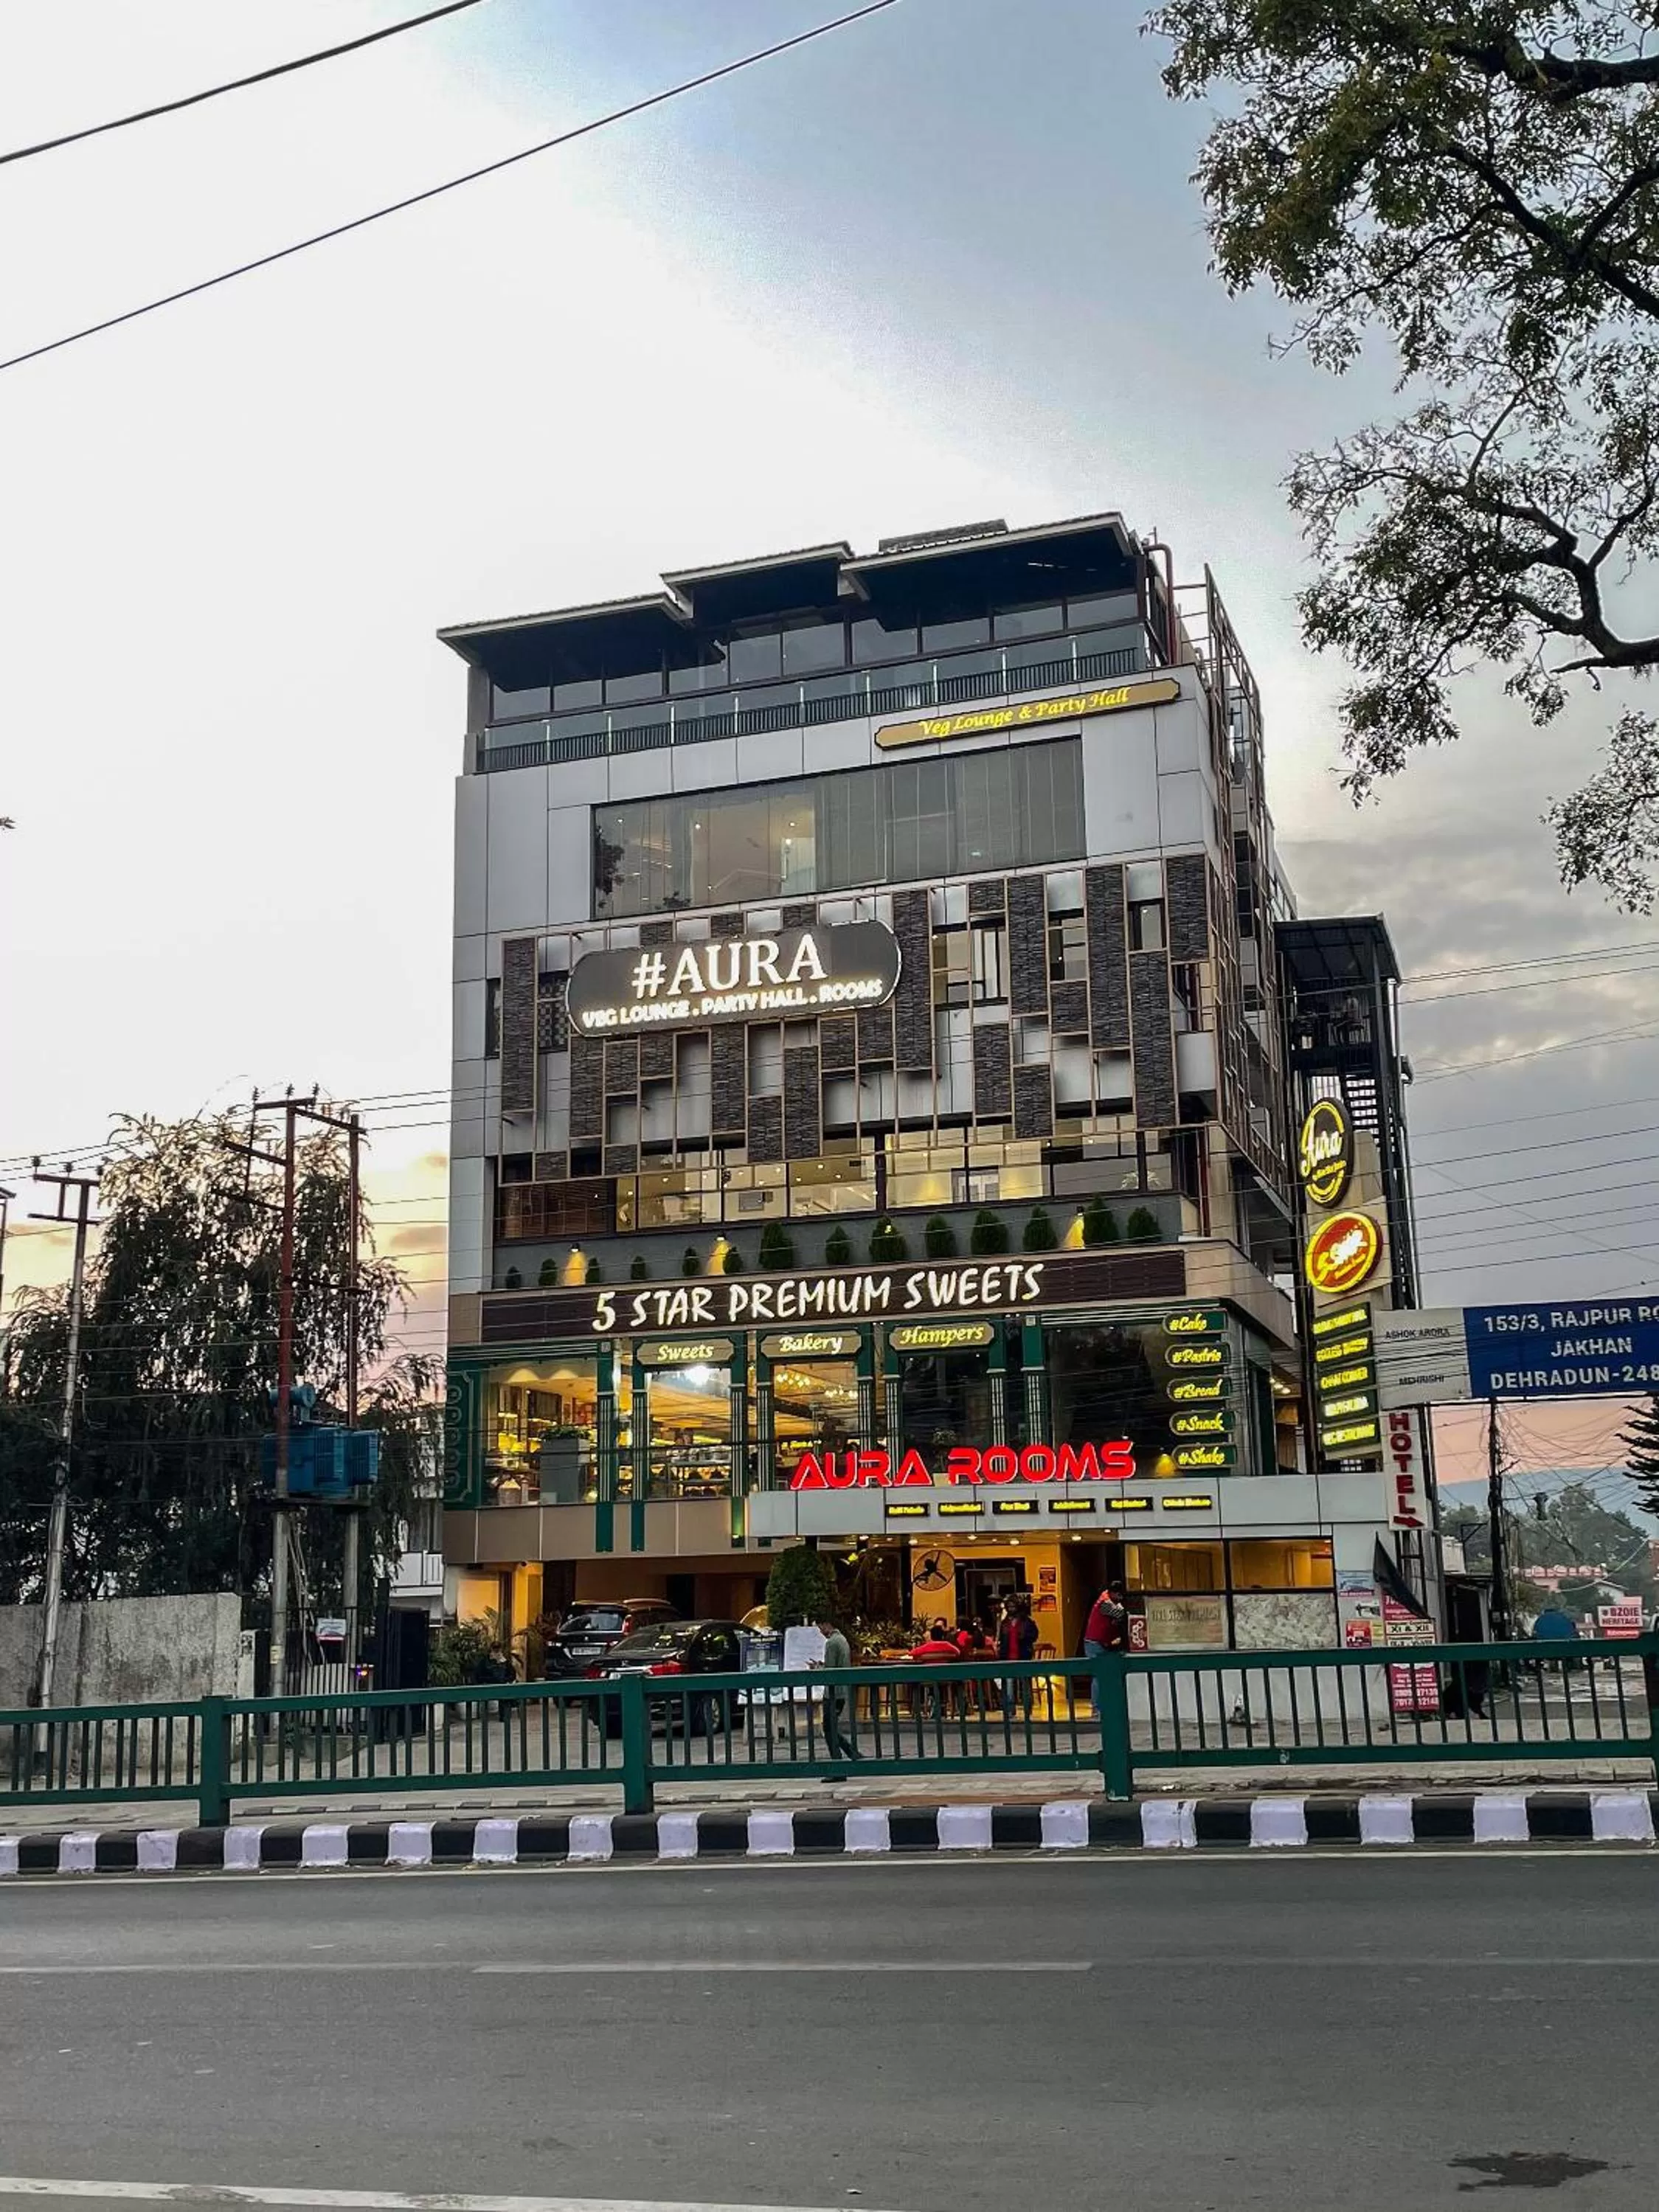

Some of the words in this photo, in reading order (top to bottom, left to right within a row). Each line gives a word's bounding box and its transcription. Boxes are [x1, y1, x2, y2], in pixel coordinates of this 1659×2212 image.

[920, 721, 950, 737] Veg
[954, 710, 1014, 731] Lounge
[1019, 707, 1033, 721] &
[1036, 698, 1087, 717] Party
[1088, 687, 1132, 707] Hall
[631, 933, 828, 999] #AURA
[583, 1008, 617, 1029] VEG
[620, 999, 690, 1024] LOUNGE
[702, 992, 758, 1015] PARTY
[761, 987, 808, 1010] HALL
[819, 979, 883, 1003] ROOMS
[592, 1292, 616, 1331] 5
[630, 1286, 716, 1327] STAR
[728, 1275, 890, 1322] PREMIUM
[903, 1263, 1045, 1310] SWEETS
[1169, 1313, 1208, 1331] #Cake
[1484, 1313, 1545, 1332] 153/3,
[1551, 1308, 1632, 1328] RAJPUR
[779, 1334, 843, 1353] Bakery
[899, 1325, 985, 1346] Hampers
[1385, 1330, 1416, 1339] ASHOK
[1551, 1336, 1632, 1357] JAKHAN
[657, 1342, 715, 1361] Sweets
[791, 1448, 932, 1490] AURA
[947, 1440, 1137, 1485] ROOMS
[1389, 1412, 1416, 1514] HOTEL
